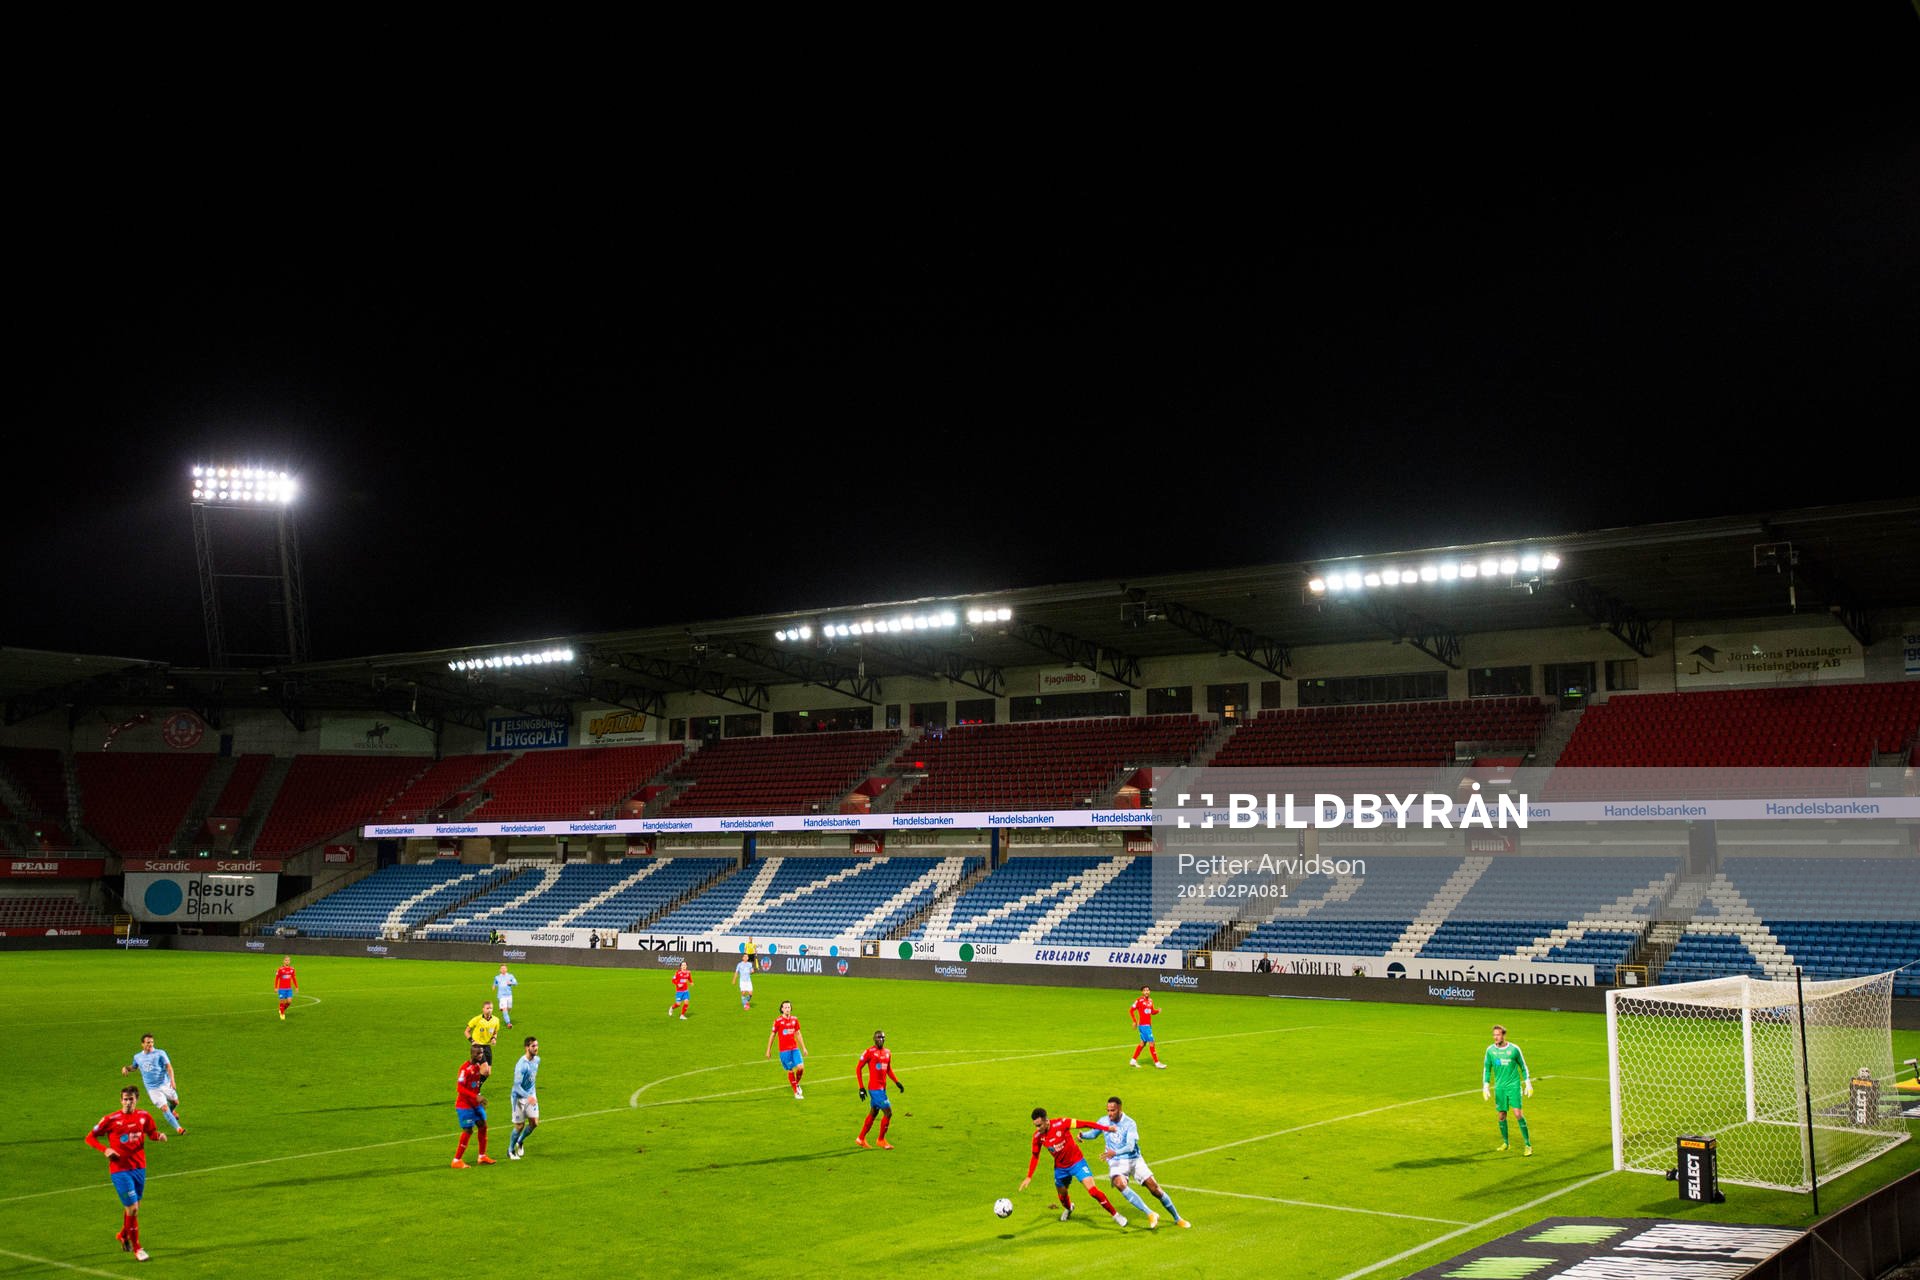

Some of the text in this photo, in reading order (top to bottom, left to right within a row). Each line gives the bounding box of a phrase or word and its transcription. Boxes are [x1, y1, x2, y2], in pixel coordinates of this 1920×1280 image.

[1747, 661, 1820, 673] Helsingborg
[1823, 657, 1841, 668] AB
[1604, 804, 1707, 817] Handelsbanken
[1766, 802, 1879, 815] Handelsbanken
[803, 818, 860, 827] Handelsbanken
[892, 816, 954, 826] Handelsbanken
[988, 814, 1054, 825] Handelsbanken
[1091, 812, 1163, 823] Handelsbanken
[436, 825, 478, 834] Handelsbanken
[500, 824, 545, 833] Handelsbanken
[569, 823, 617, 831] Handelsbanken
[642, 821, 693, 830] Handelsbanken
[720, 819, 774, 829] Handelsbanken
[374, 827, 415, 835] Handelsbanken
[1471, 839, 1505, 851] PUMA
[144, 860, 191, 871] Scandic
[217, 860, 262, 871] Scandic
[188, 880, 255, 897] Resurs
[187, 898, 234, 915] Bank
[530, 931, 576, 944] vasatorp.golf
[914, 942, 935, 953] Solid
[975, 944, 997, 955] Solid
[1035, 950, 1091, 963] EKBLADHS
[1108, 951, 1167, 965] EKBLADHS
[786, 957, 823, 973] OLYMPIA
[934, 965, 968, 975] kondektor
[1290, 958, 1341, 976] MÖBLER
[1160, 973, 1199, 986] kondektor
[1428, 985, 1476, 999] kondektor
[1687, 1153, 1701, 1200] SELECT
